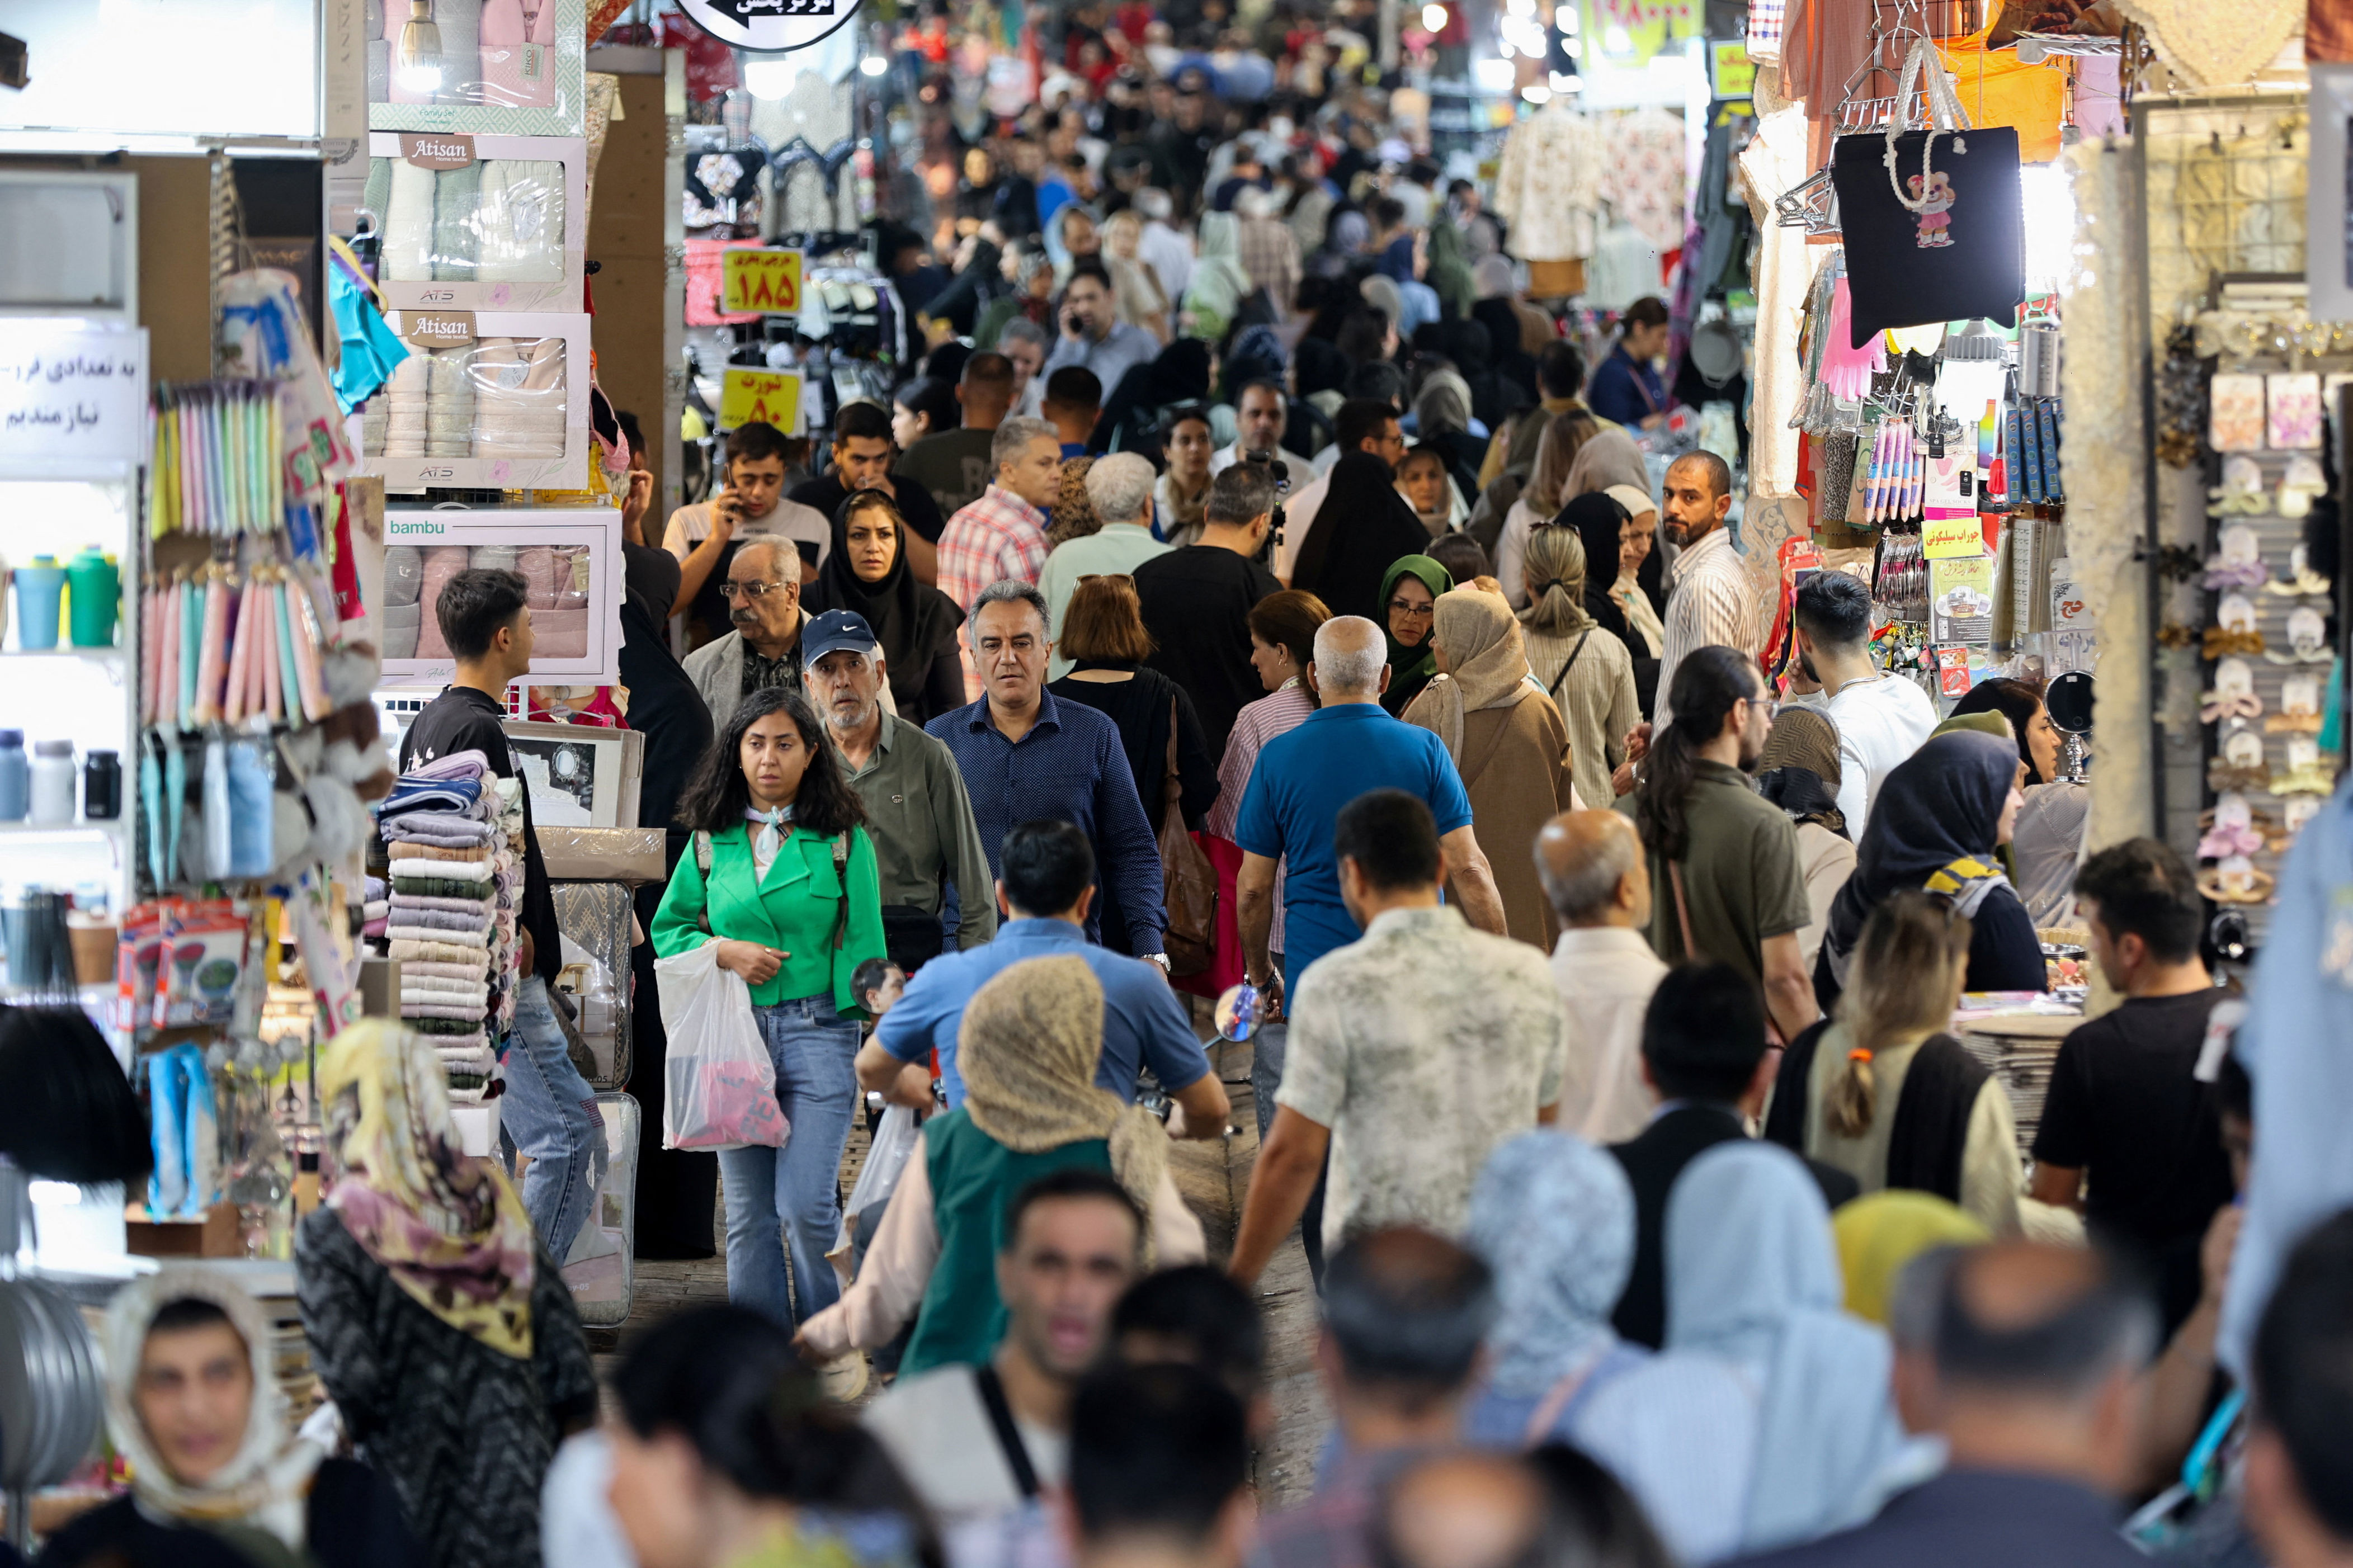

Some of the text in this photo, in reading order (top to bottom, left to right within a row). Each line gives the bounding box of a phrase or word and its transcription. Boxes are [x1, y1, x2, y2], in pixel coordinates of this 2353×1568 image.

[420, 109, 442, 118] Family
[412, 140, 467, 158] Atisan
[419, 290, 455, 300] ATS
[739, 272, 794, 308] ۱۸۵
[412, 317, 468, 336] Atisan
[419, 466, 454, 477] ATS
[390, 520, 445, 534] bambu
[1926, 528, 1979, 546] جوراب سیلیکونی
[1944, 563, 1958, 577] فرش
